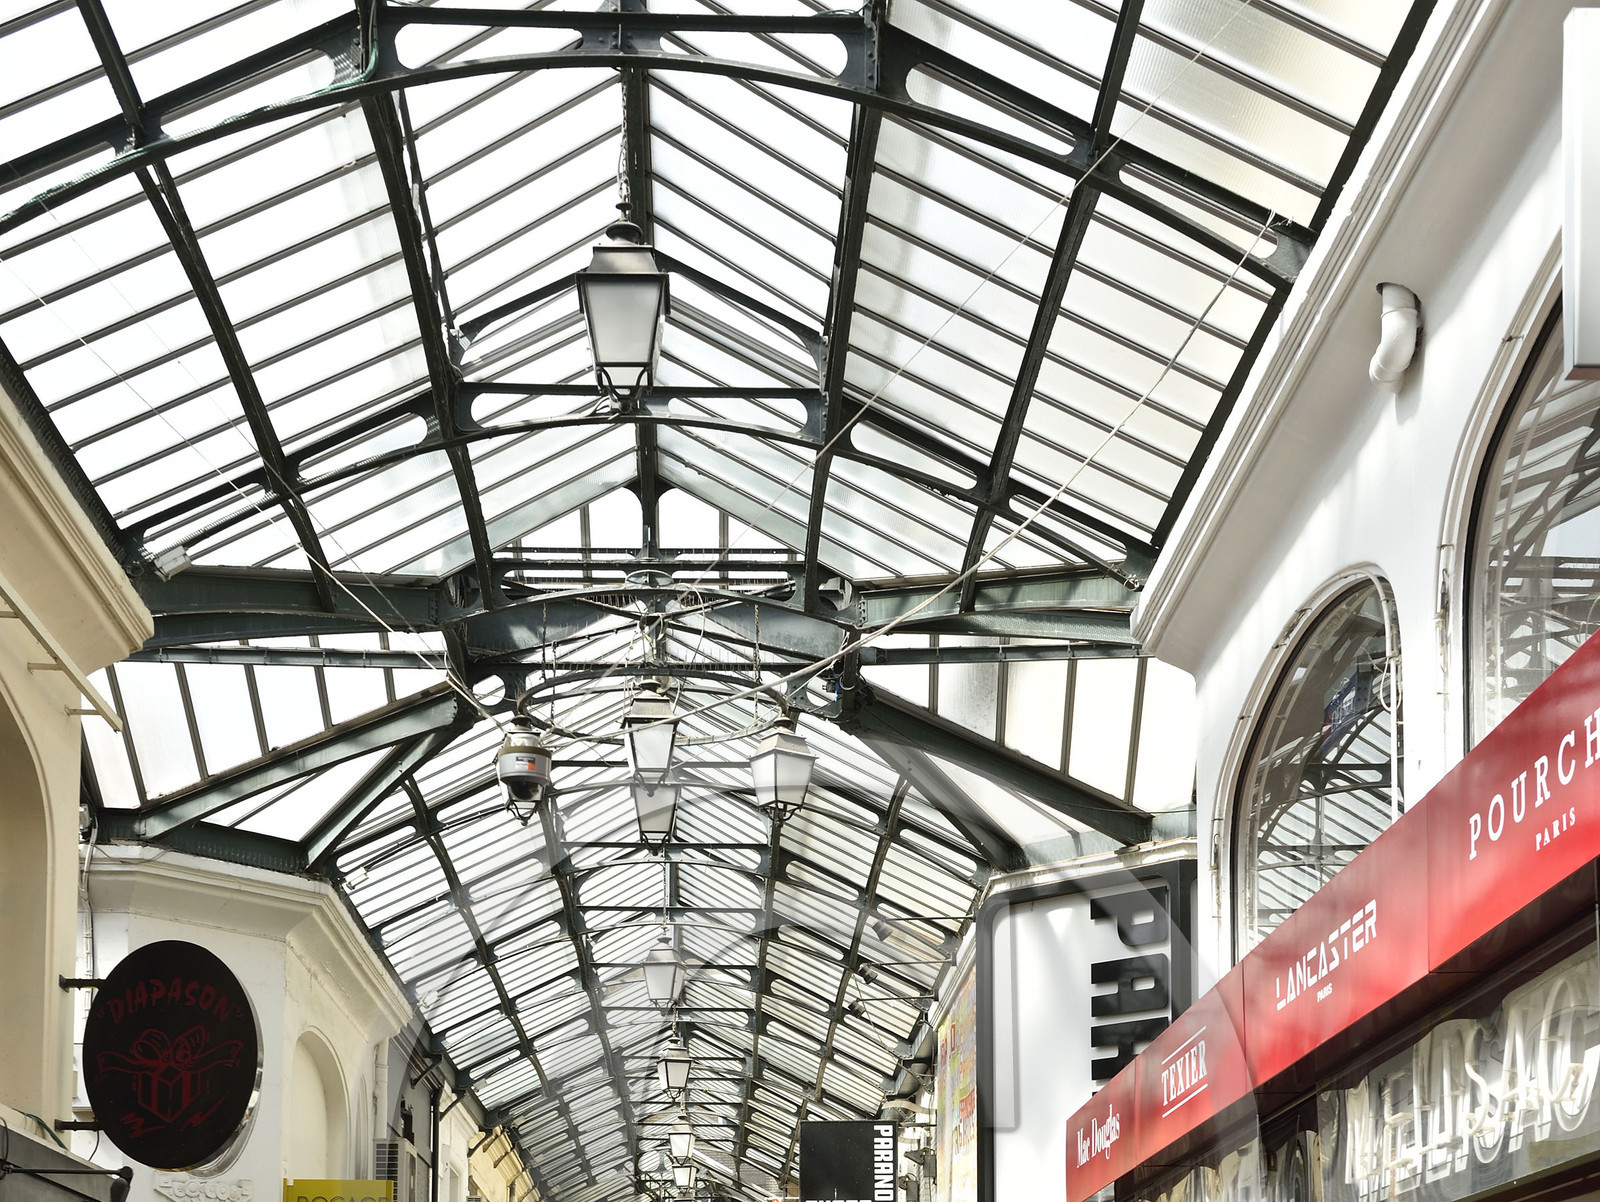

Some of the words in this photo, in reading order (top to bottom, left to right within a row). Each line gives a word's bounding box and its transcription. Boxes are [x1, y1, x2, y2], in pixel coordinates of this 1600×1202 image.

[1535, 807, 1576, 852] PARIS
[1276, 898, 1377, 1011] LANCASTER
[1317, 982, 1333, 1003] PARIS
[1161, 1039, 1208, 1107] TEXIER
[873, 1124, 894, 1201] PARANO
[1076, 1126, 1090, 1168] Mac
[1091, 1103, 1120, 1160] Douglas
